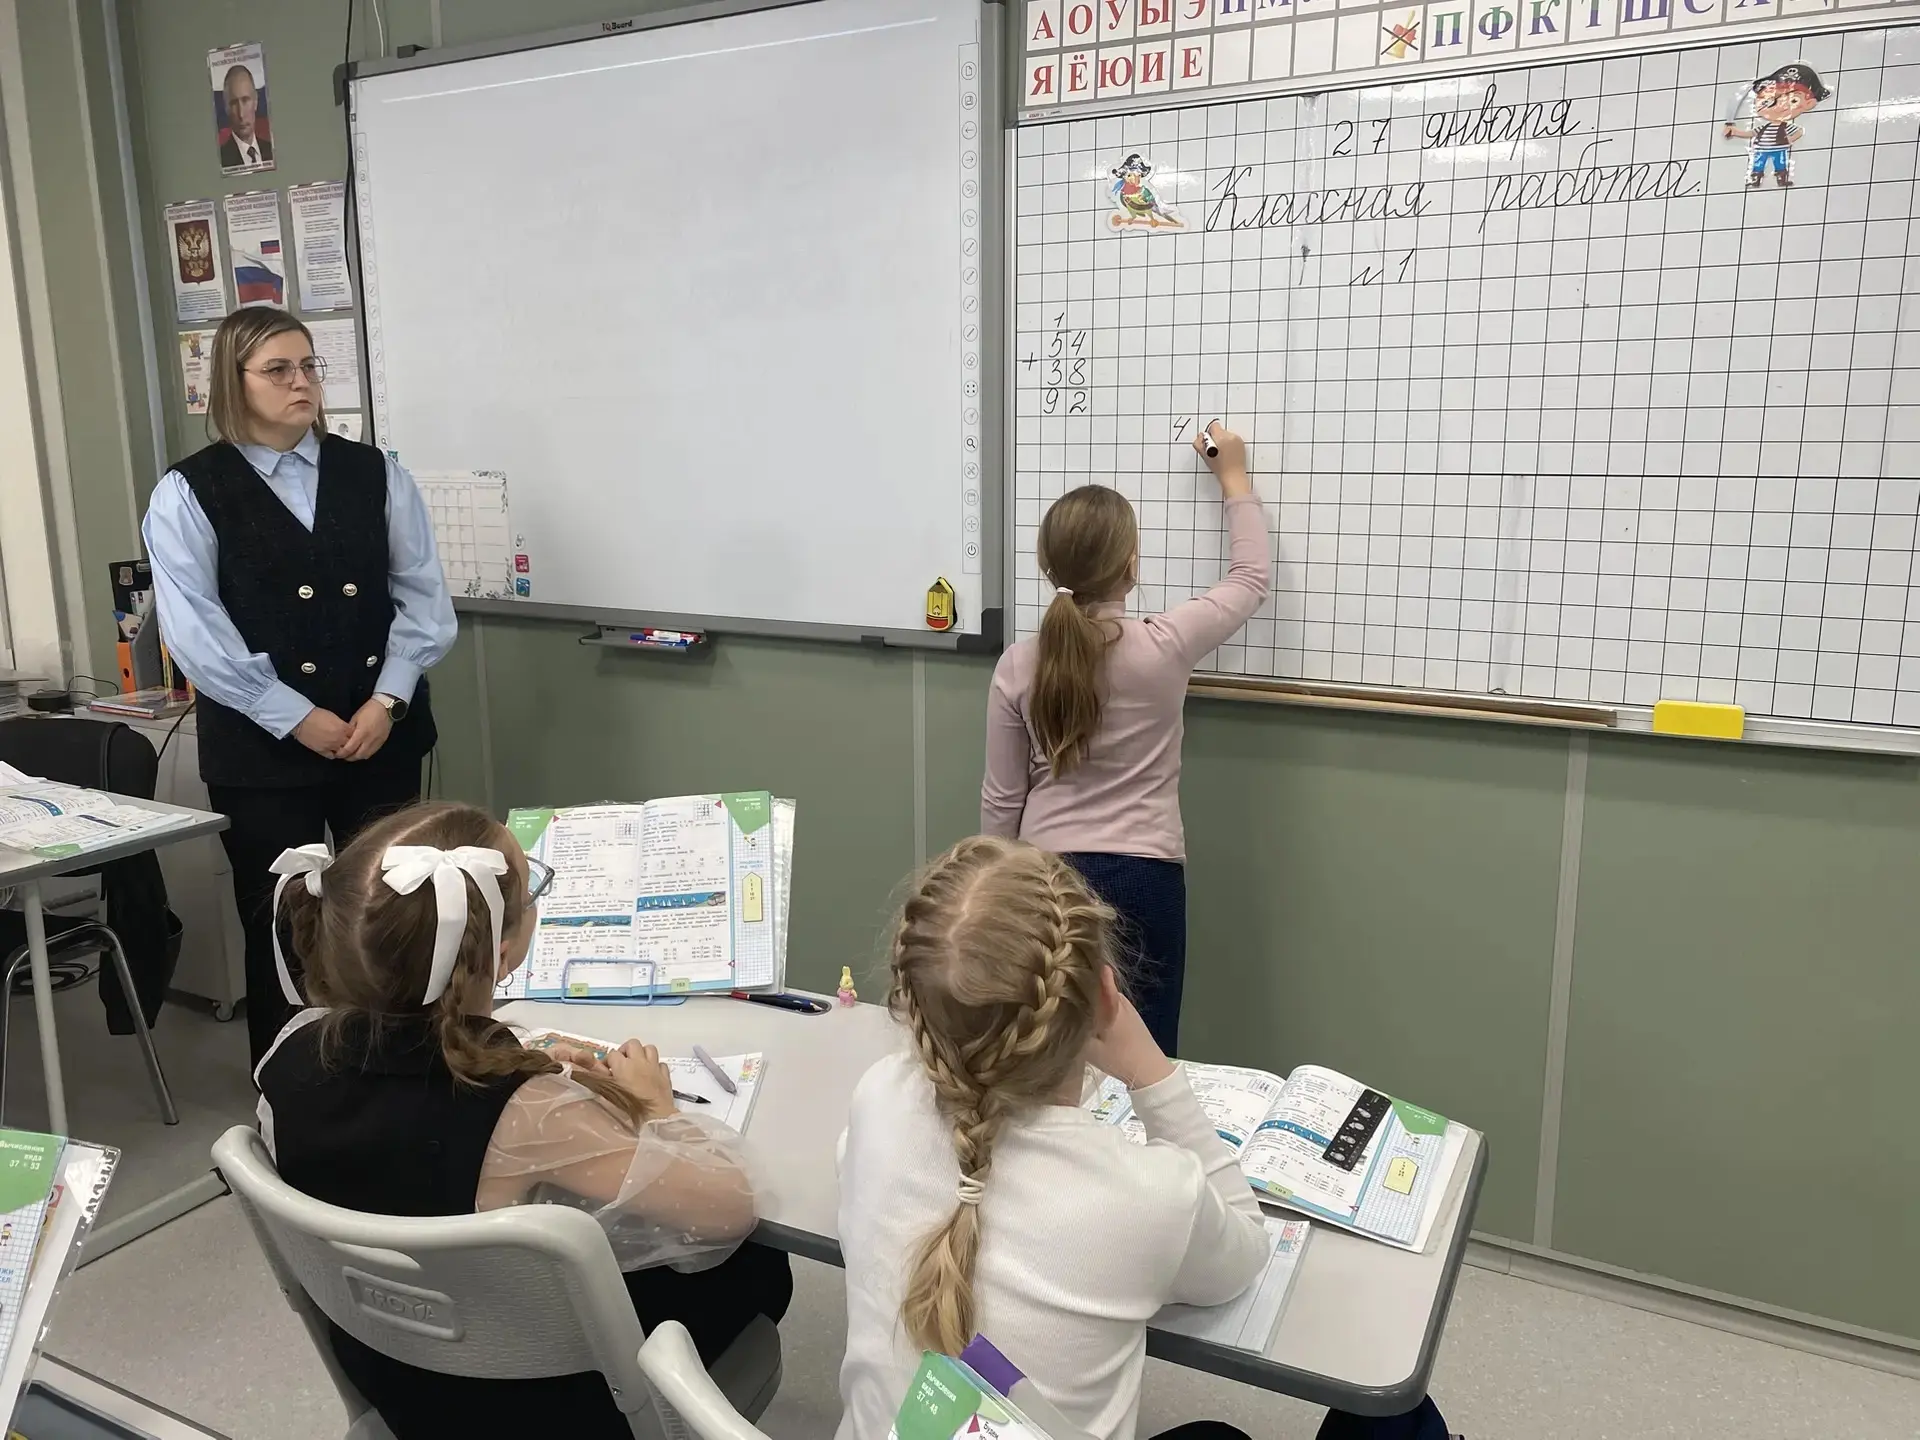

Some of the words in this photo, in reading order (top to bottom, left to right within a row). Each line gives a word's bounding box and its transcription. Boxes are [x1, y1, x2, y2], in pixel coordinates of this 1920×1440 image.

[1032, 10, 1055, 40] А
[1069, 5, 1093, 35] О
[1105, 0, 1128, 30] У
[1030, 65, 1054, 96] Я
[1067, 54, 1088, 92] Ё
[1098, 57, 1133, 88] Ю
[1140, 51, 1167, 83] И
[1180, 47, 1203, 78] Е
[1431, 11, 1465, 48] П
[1478, 5, 1514, 40] Ф
[1528, 0, 1561, 36] К
[1332, 119, 1391, 156] 27
[1205, 165, 1432, 232] Классная
[1053, 312, 1065, 328] 1
[1048, 330, 1087, 358] 54
[1047, 358, 1087, 386] 38
[1043, 387, 1087, 414] 92
[1173, 416, 1191, 441] 4
